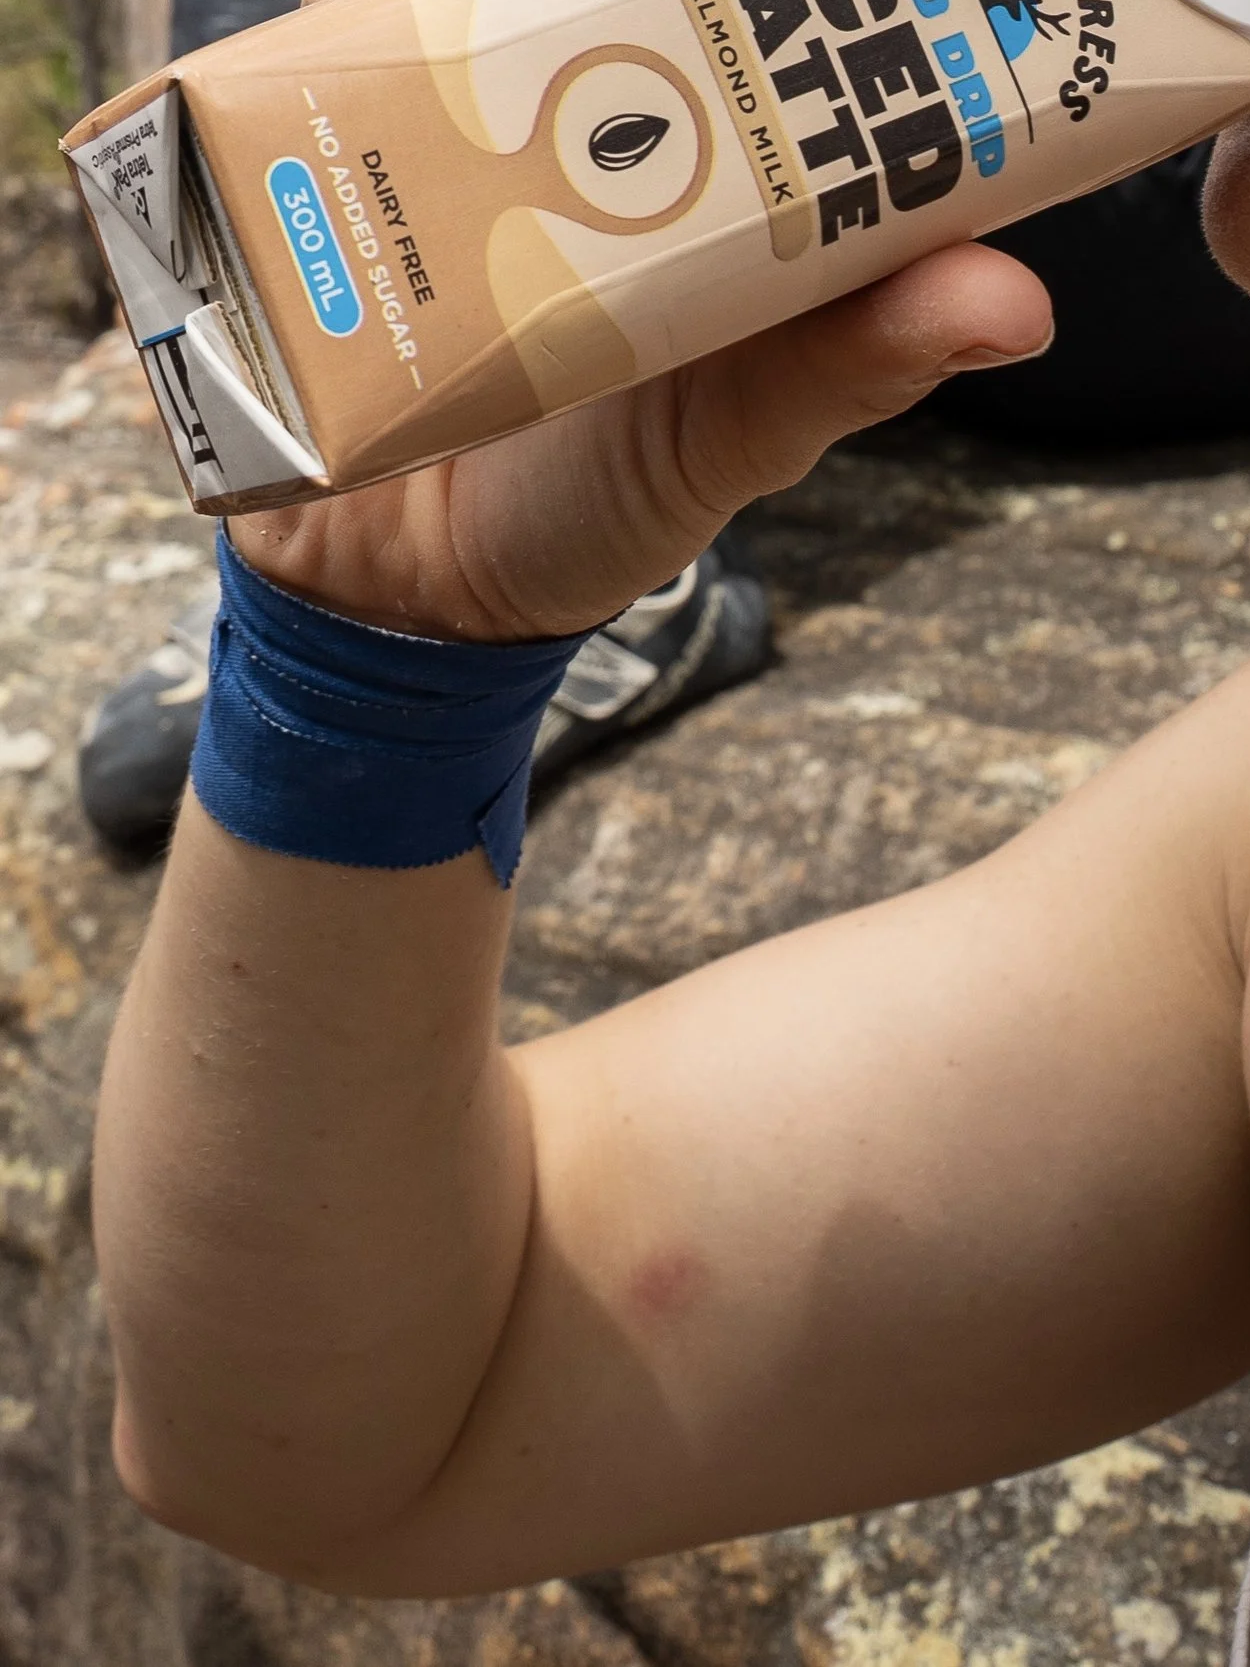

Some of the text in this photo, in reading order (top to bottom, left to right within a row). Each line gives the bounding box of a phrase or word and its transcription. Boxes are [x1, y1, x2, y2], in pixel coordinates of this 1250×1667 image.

[130, 153, 154, 178] Tetra
[750, 124, 795, 204] MILK
[931, 31, 1007, 178] DRIP
[283, 187, 346, 314] 300 mL
[309, 115, 418, 361] NO ADDED SUGAR
[361, 149, 436, 306] DAIRY FREE
